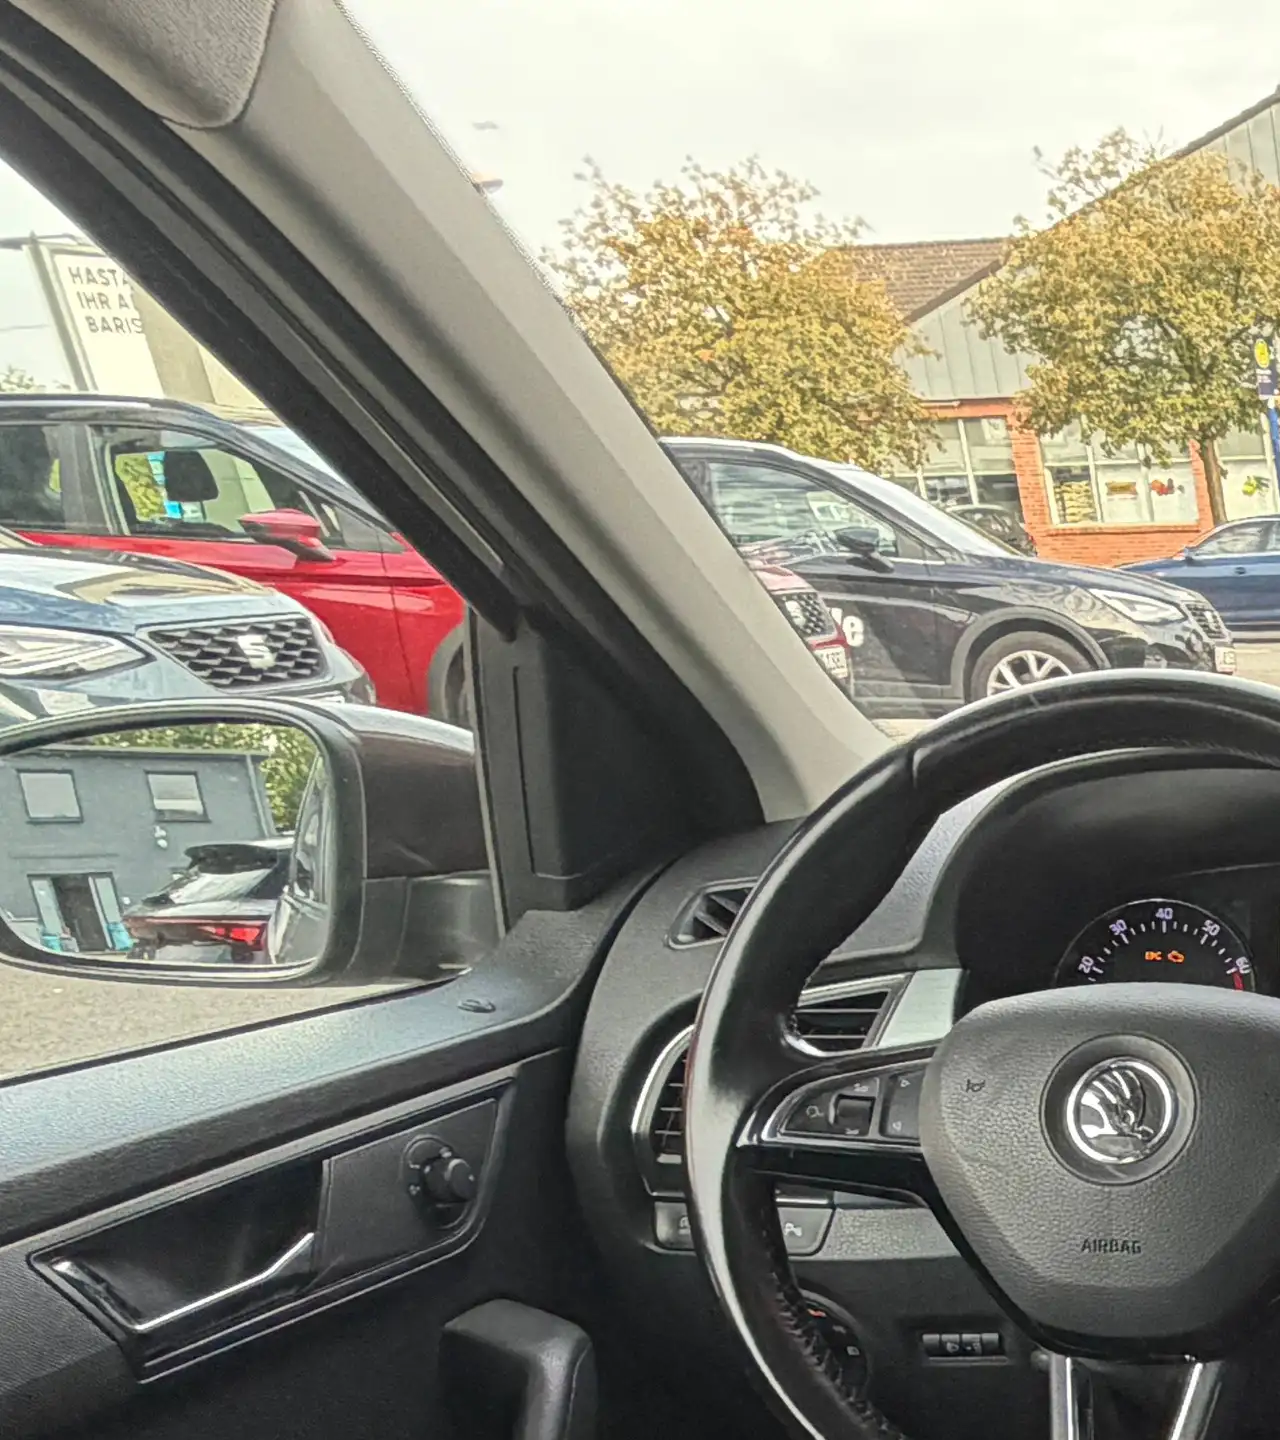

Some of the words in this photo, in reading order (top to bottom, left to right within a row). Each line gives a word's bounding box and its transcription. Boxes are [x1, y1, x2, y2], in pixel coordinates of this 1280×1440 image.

[77, 291, 112, 310] IHR
[1155, 907, 1174, 920] 40
[1109, 919, 1128, 936] 30
[1202, 919, 1221, 936] 50
[1078, 955, 1095, 975] 20
[1081, 1238, 1142, 1254] AIRBAG
